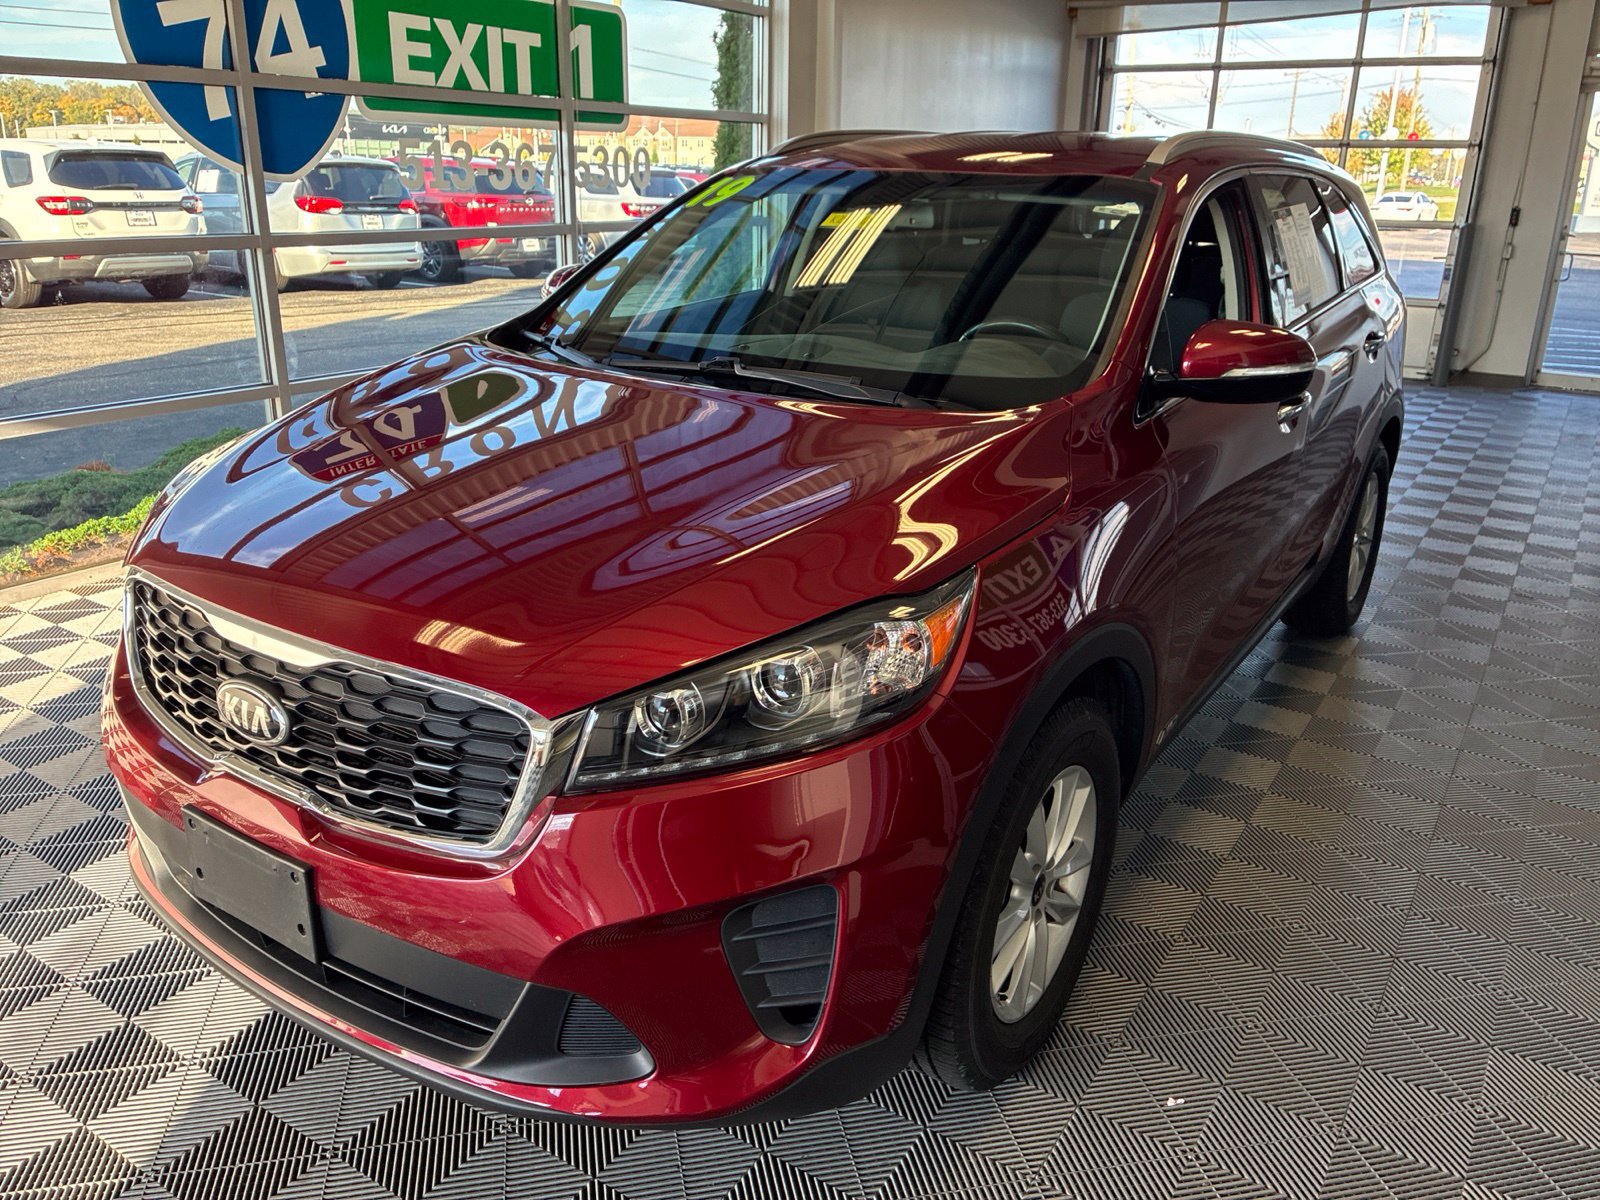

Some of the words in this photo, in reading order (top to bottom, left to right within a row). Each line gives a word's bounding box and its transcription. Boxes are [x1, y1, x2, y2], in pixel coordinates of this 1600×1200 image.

[156, 0, 327, 122] 74
[388, 11, 542, 96] EXIT
[569, 24, 594, 99] 1
[381, 124, 408, 134] KIA
[685, 175, 756, 208] 19
[224, 691, 272, 738] KIA
